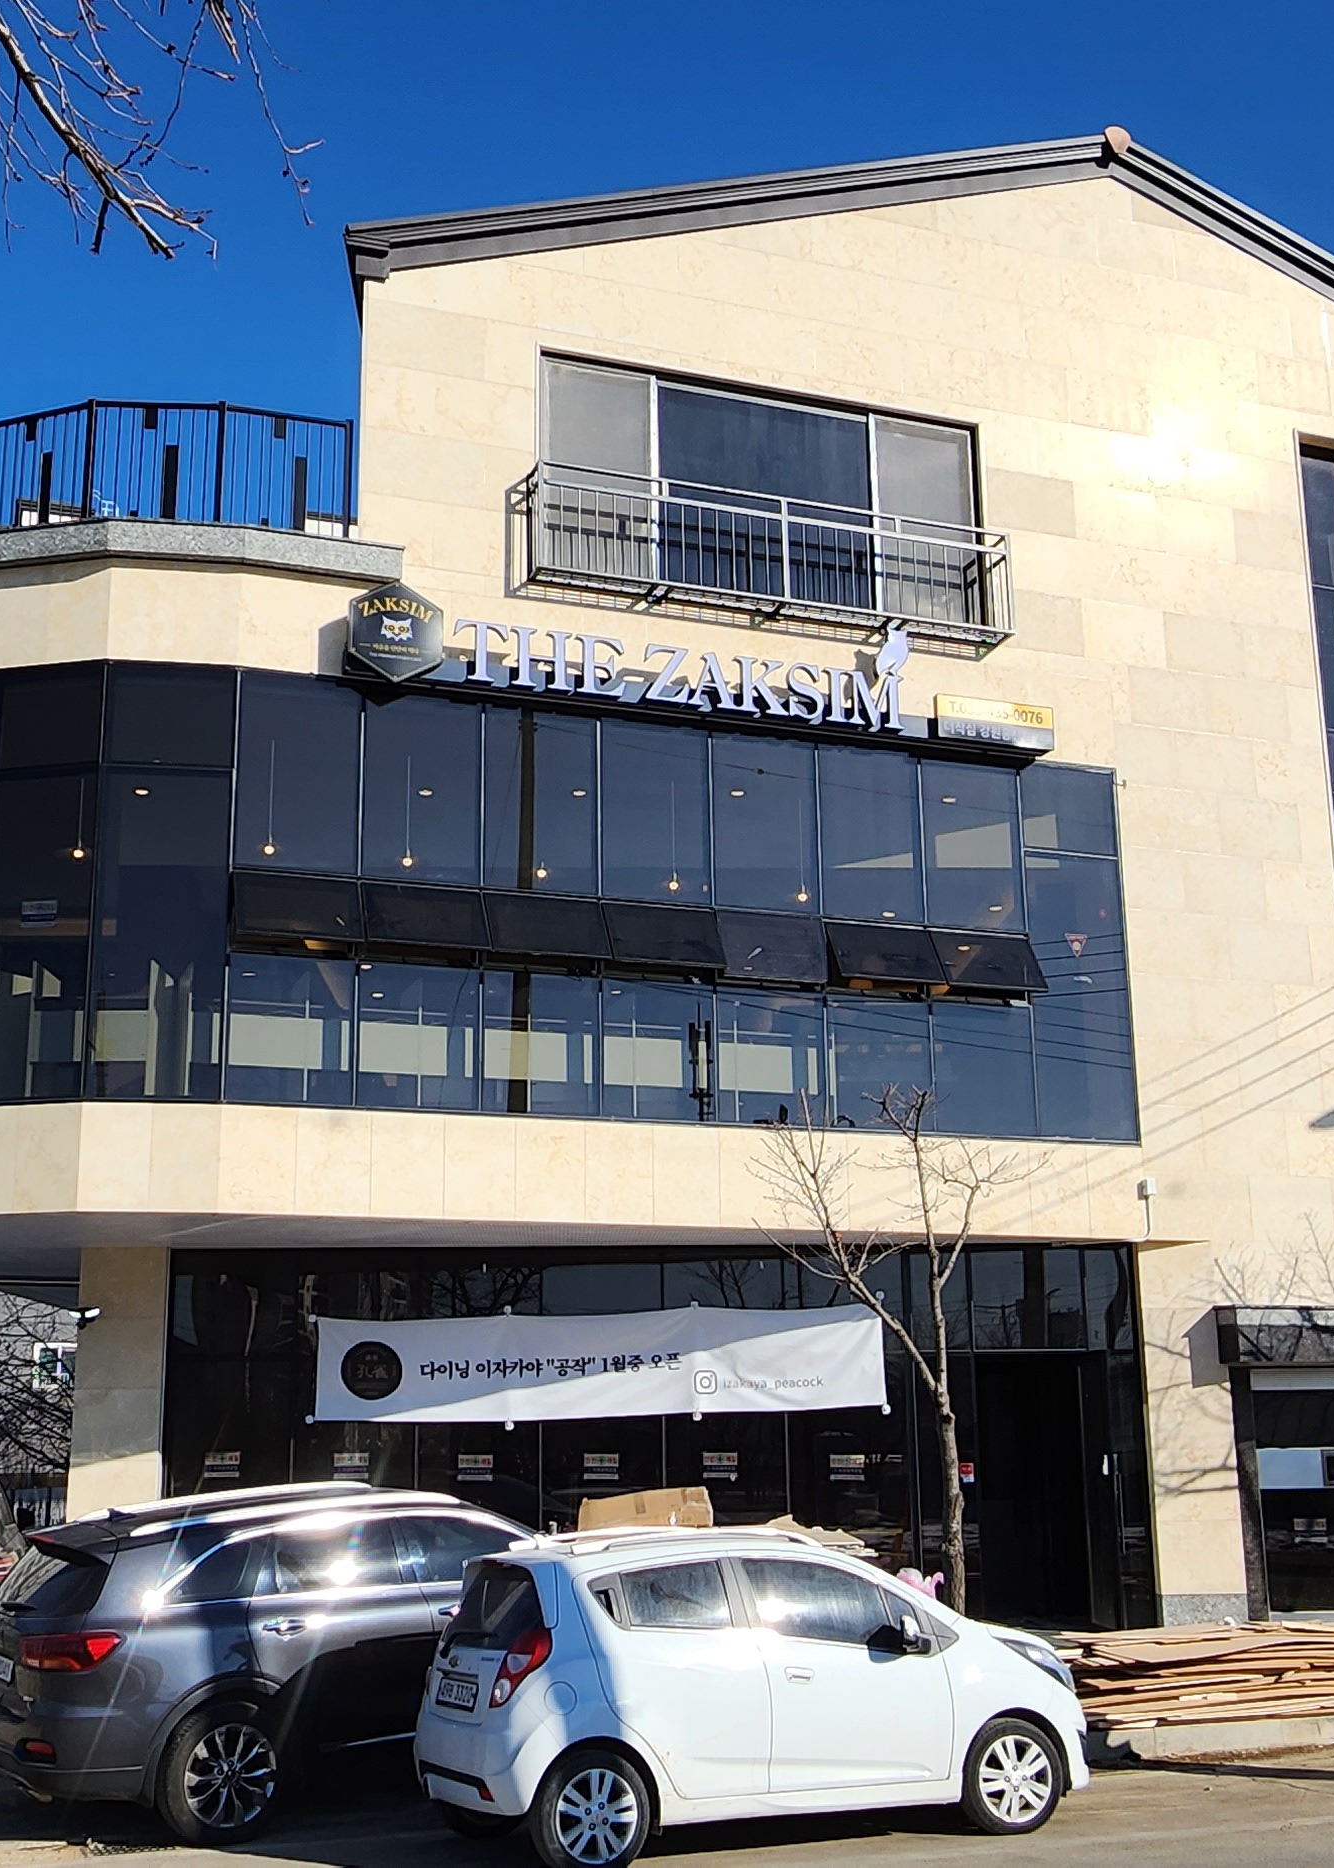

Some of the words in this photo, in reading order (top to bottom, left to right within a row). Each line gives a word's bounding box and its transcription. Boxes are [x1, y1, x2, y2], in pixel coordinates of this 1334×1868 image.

[358, 597, 434, 623] ZAKSIM
[453, 618, 625, 697] THE
[644, 643, 905, 730] ZAKSIM
[420, 1360, 469, 1380] 다이닝
[476, 1358, 543, 1379] 이자카야
[547, 1357, 596, 1376] "공작"
[601, 1354, 645, 1373] 1월중
[648, 1352, 683, 1370] 오픈
[723, 1376, 824, 1390] izakaya_peacock
